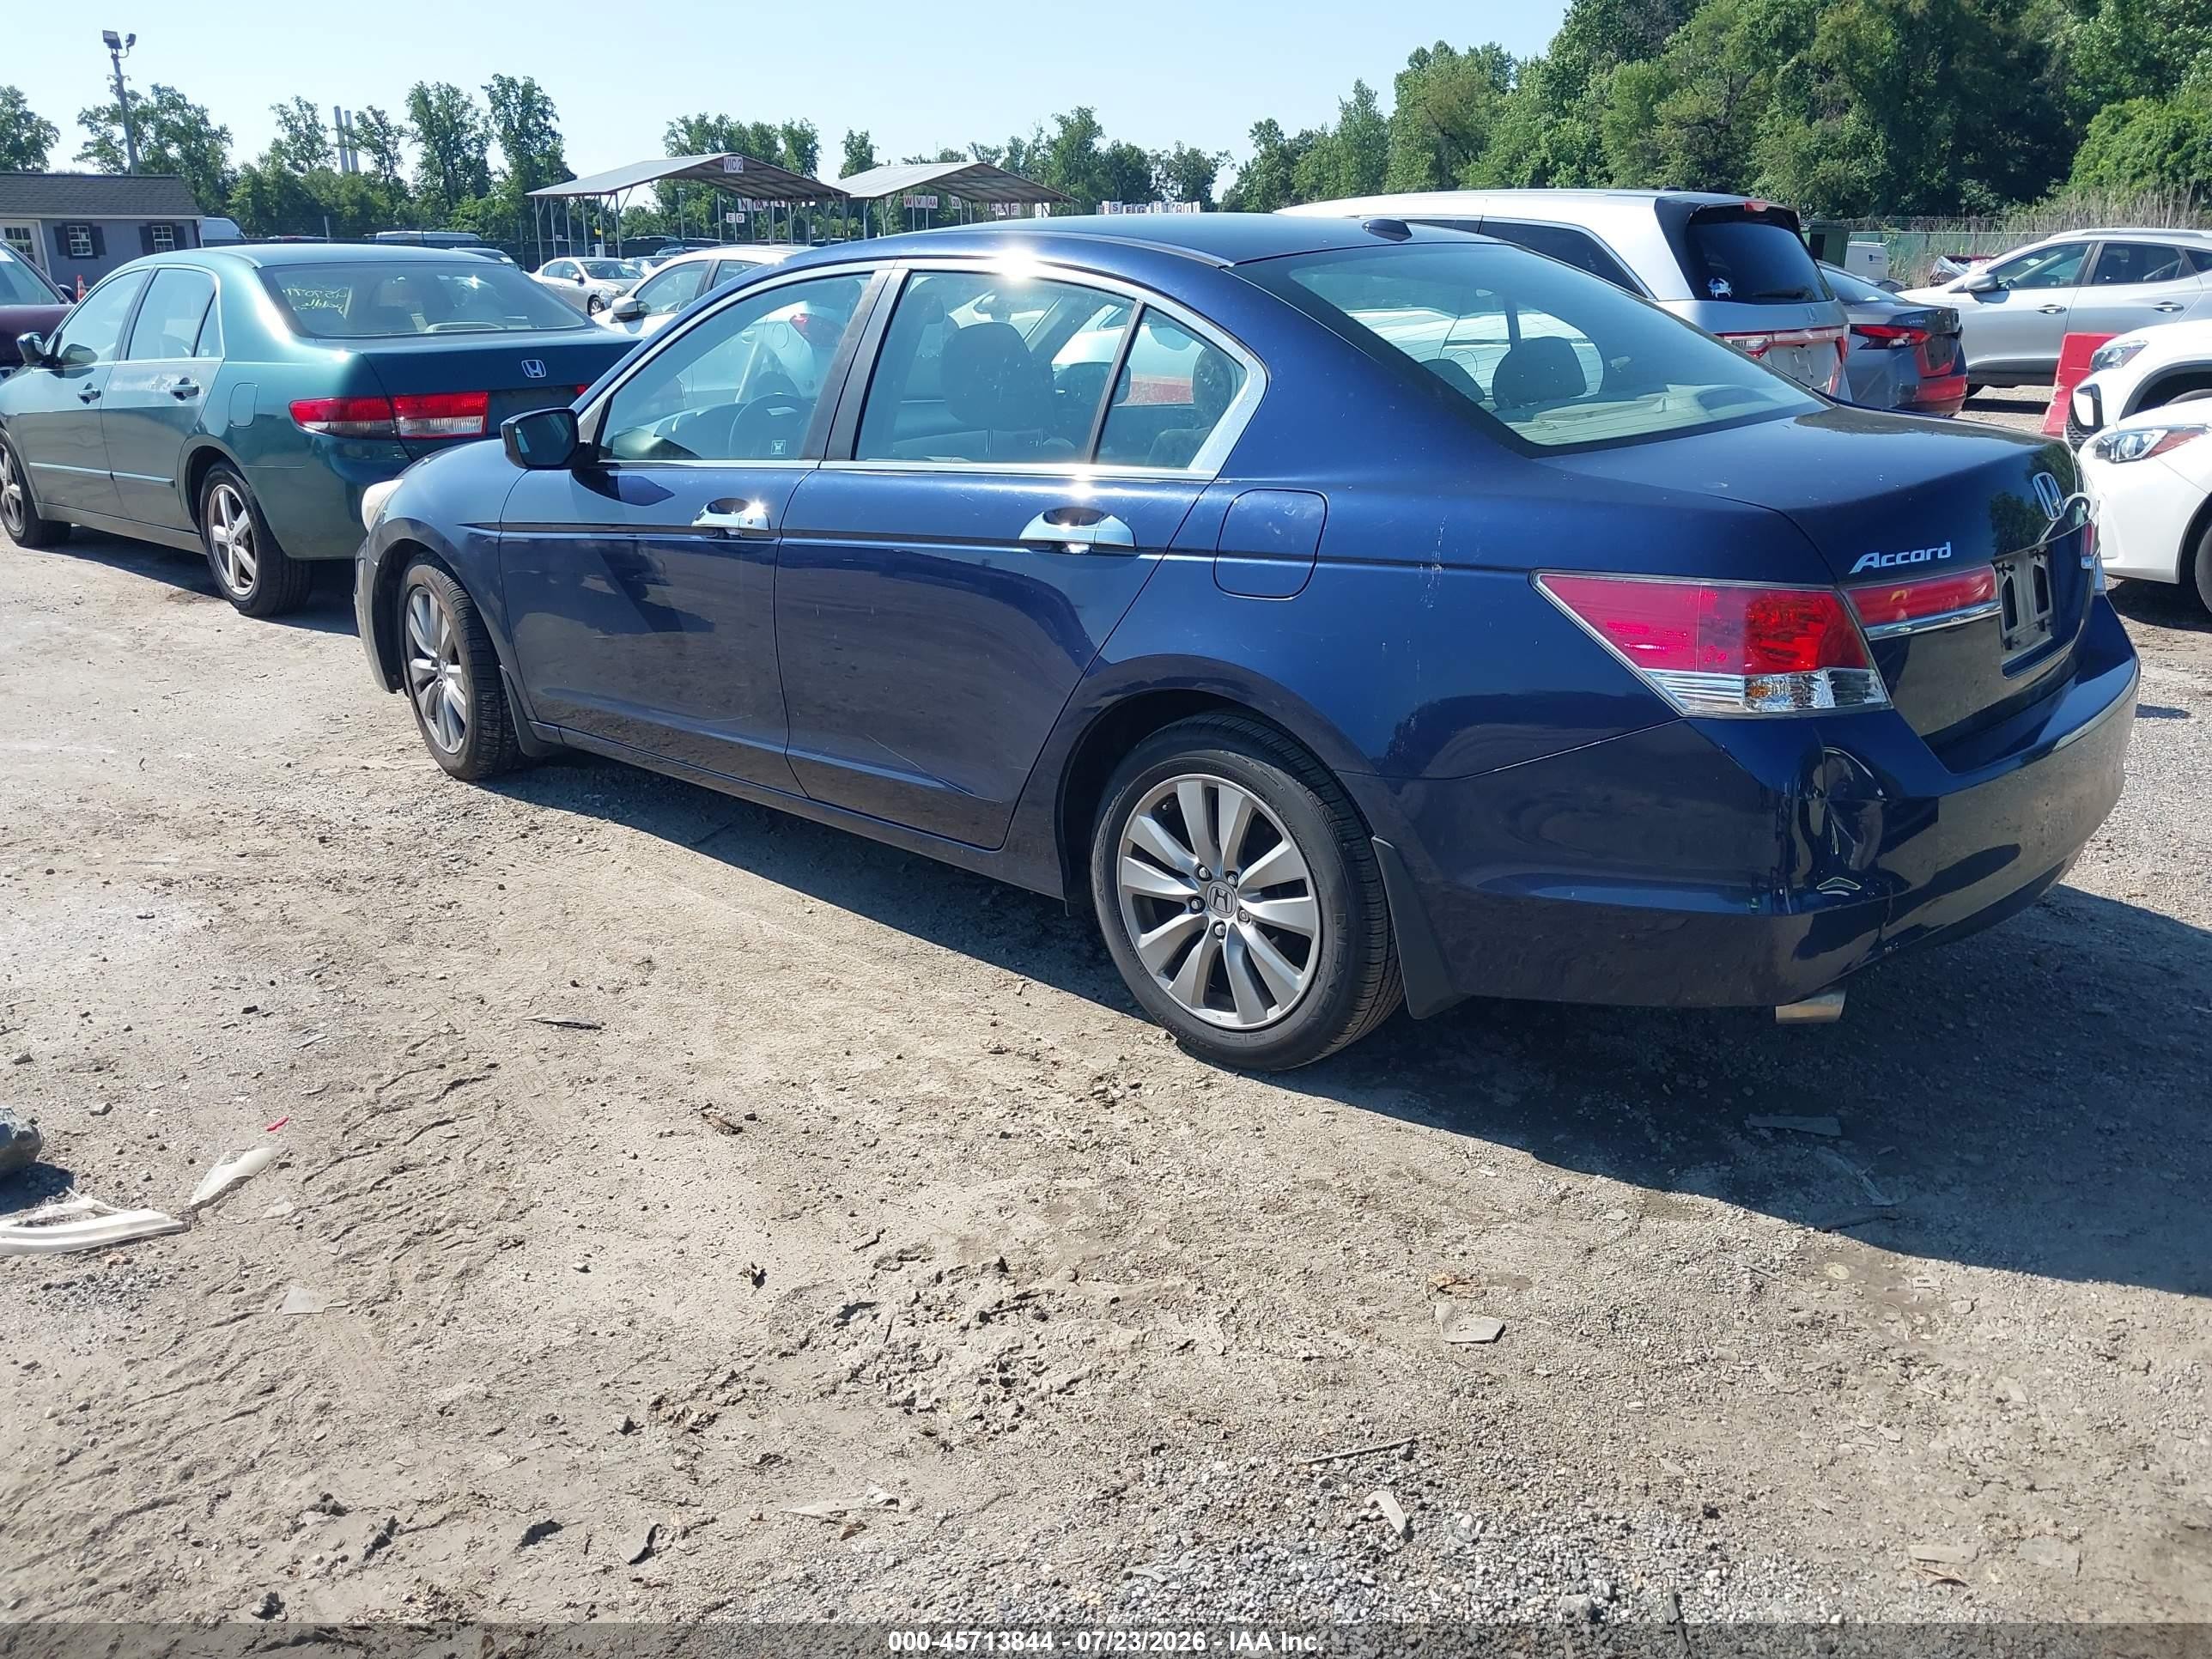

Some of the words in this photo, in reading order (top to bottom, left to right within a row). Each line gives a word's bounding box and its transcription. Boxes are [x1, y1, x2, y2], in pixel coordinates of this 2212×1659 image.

[724, 158, 737, 171] VIC
[738, 158, 744, 171] 2
[1848, 541, 1951, 574] Accord
